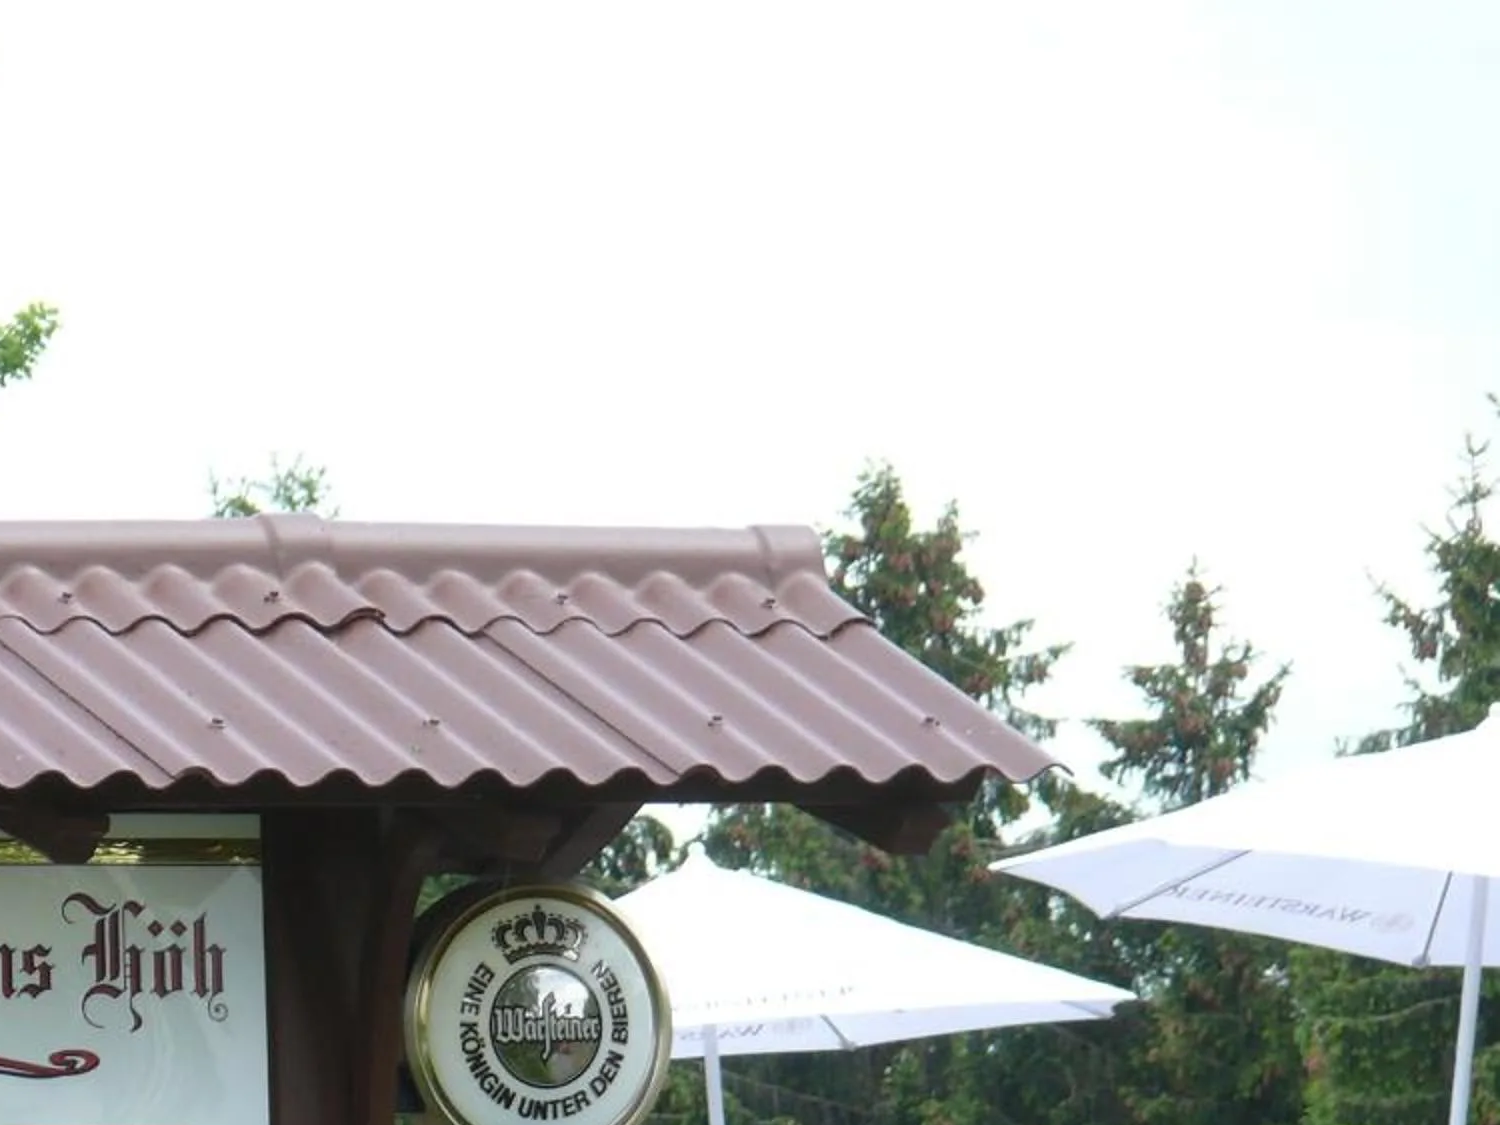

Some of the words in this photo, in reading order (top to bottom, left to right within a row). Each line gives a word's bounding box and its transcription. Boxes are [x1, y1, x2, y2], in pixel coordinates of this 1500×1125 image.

[61, 891, 229, 1033] Höh
[459, 961, 495, 1017] EINE
[590, 958, 630, 1046] BIEREN
[459, 1021, 517, 1111] KÖNIGIN
[589, 1050, 626, 1098] DEN
[517, 1089, 592, 1121] UNTER
